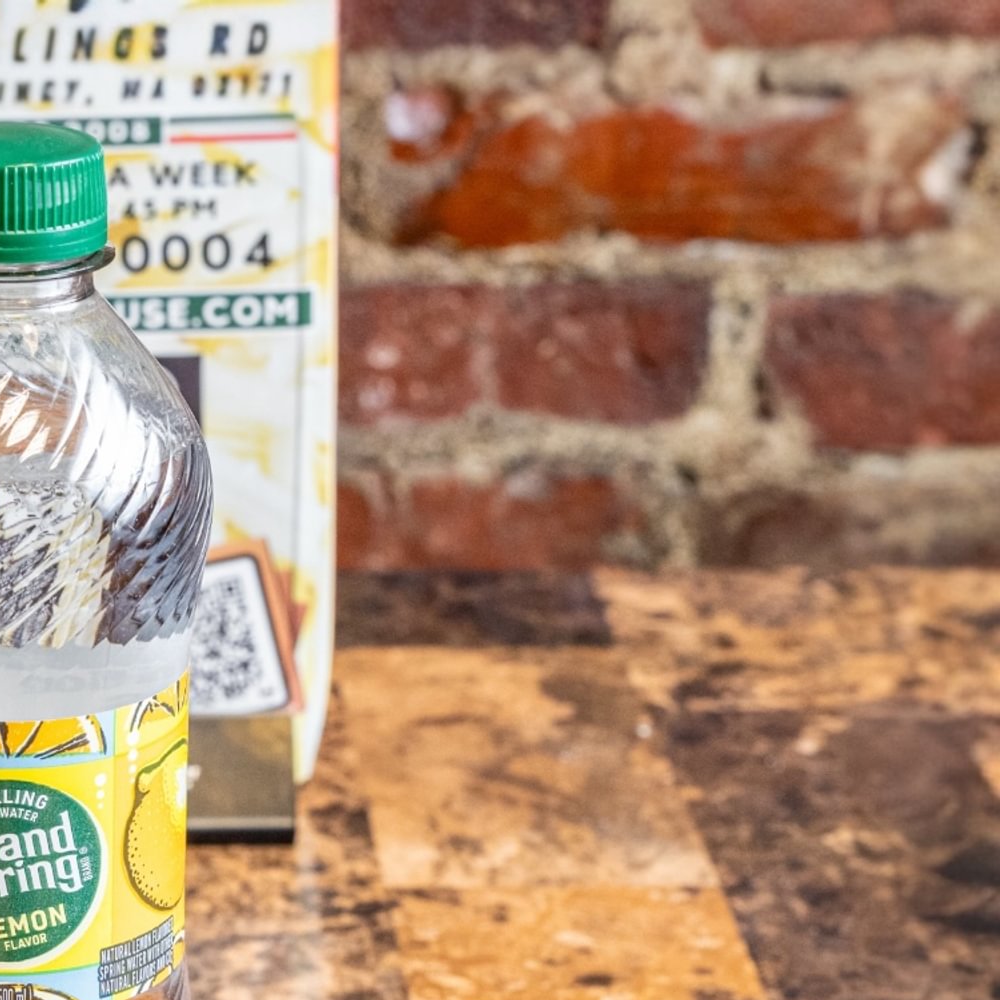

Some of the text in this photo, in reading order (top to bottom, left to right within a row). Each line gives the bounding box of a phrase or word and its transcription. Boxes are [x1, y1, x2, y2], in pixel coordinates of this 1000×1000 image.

[210, 22, 268, 56] RD
[122, 78, 164, 99] MA
[109, 165, 129, 188] A
[151, 160, 258, 188] WEEK
[121, 230, 275, 274] 0004
[0, 807, 39, 823] WATER
[3, 933, 48, 952] FLAVOR
[101, 941, 132, 965] NATURAL
[99, 959, 126, 981] SPRING
[127, 950, 147, 972] WATER
[100, 973, 131, 996] NATURAL
